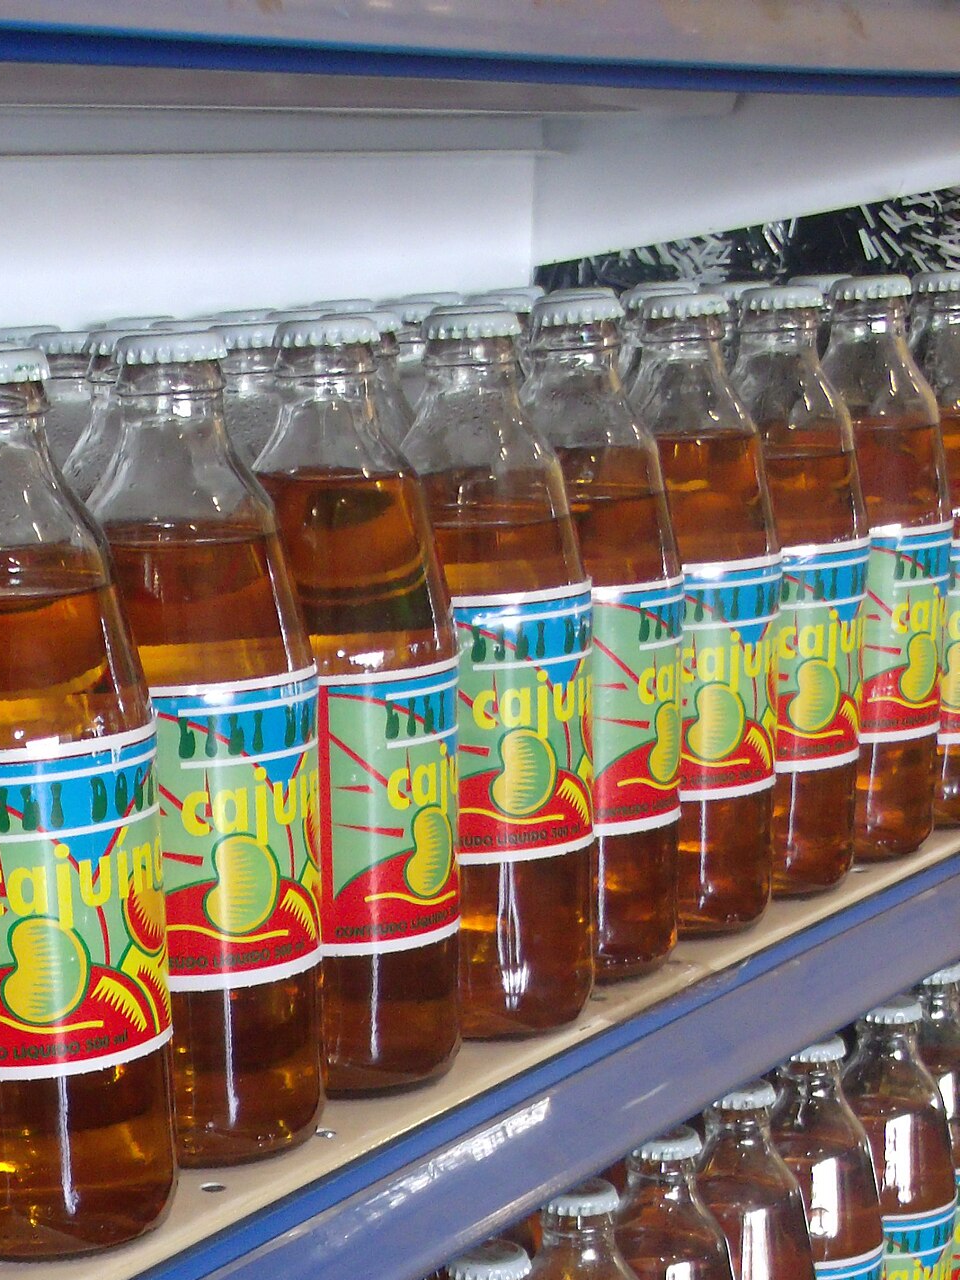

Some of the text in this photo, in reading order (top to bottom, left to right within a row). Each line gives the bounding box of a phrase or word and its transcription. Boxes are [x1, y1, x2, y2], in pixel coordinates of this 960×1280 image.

[212, 947, 271, 968] LÍQUIDO
[13, 1033, 81, 1060] LÍQUIDO
[85, 1034, 110, 1055] 500
